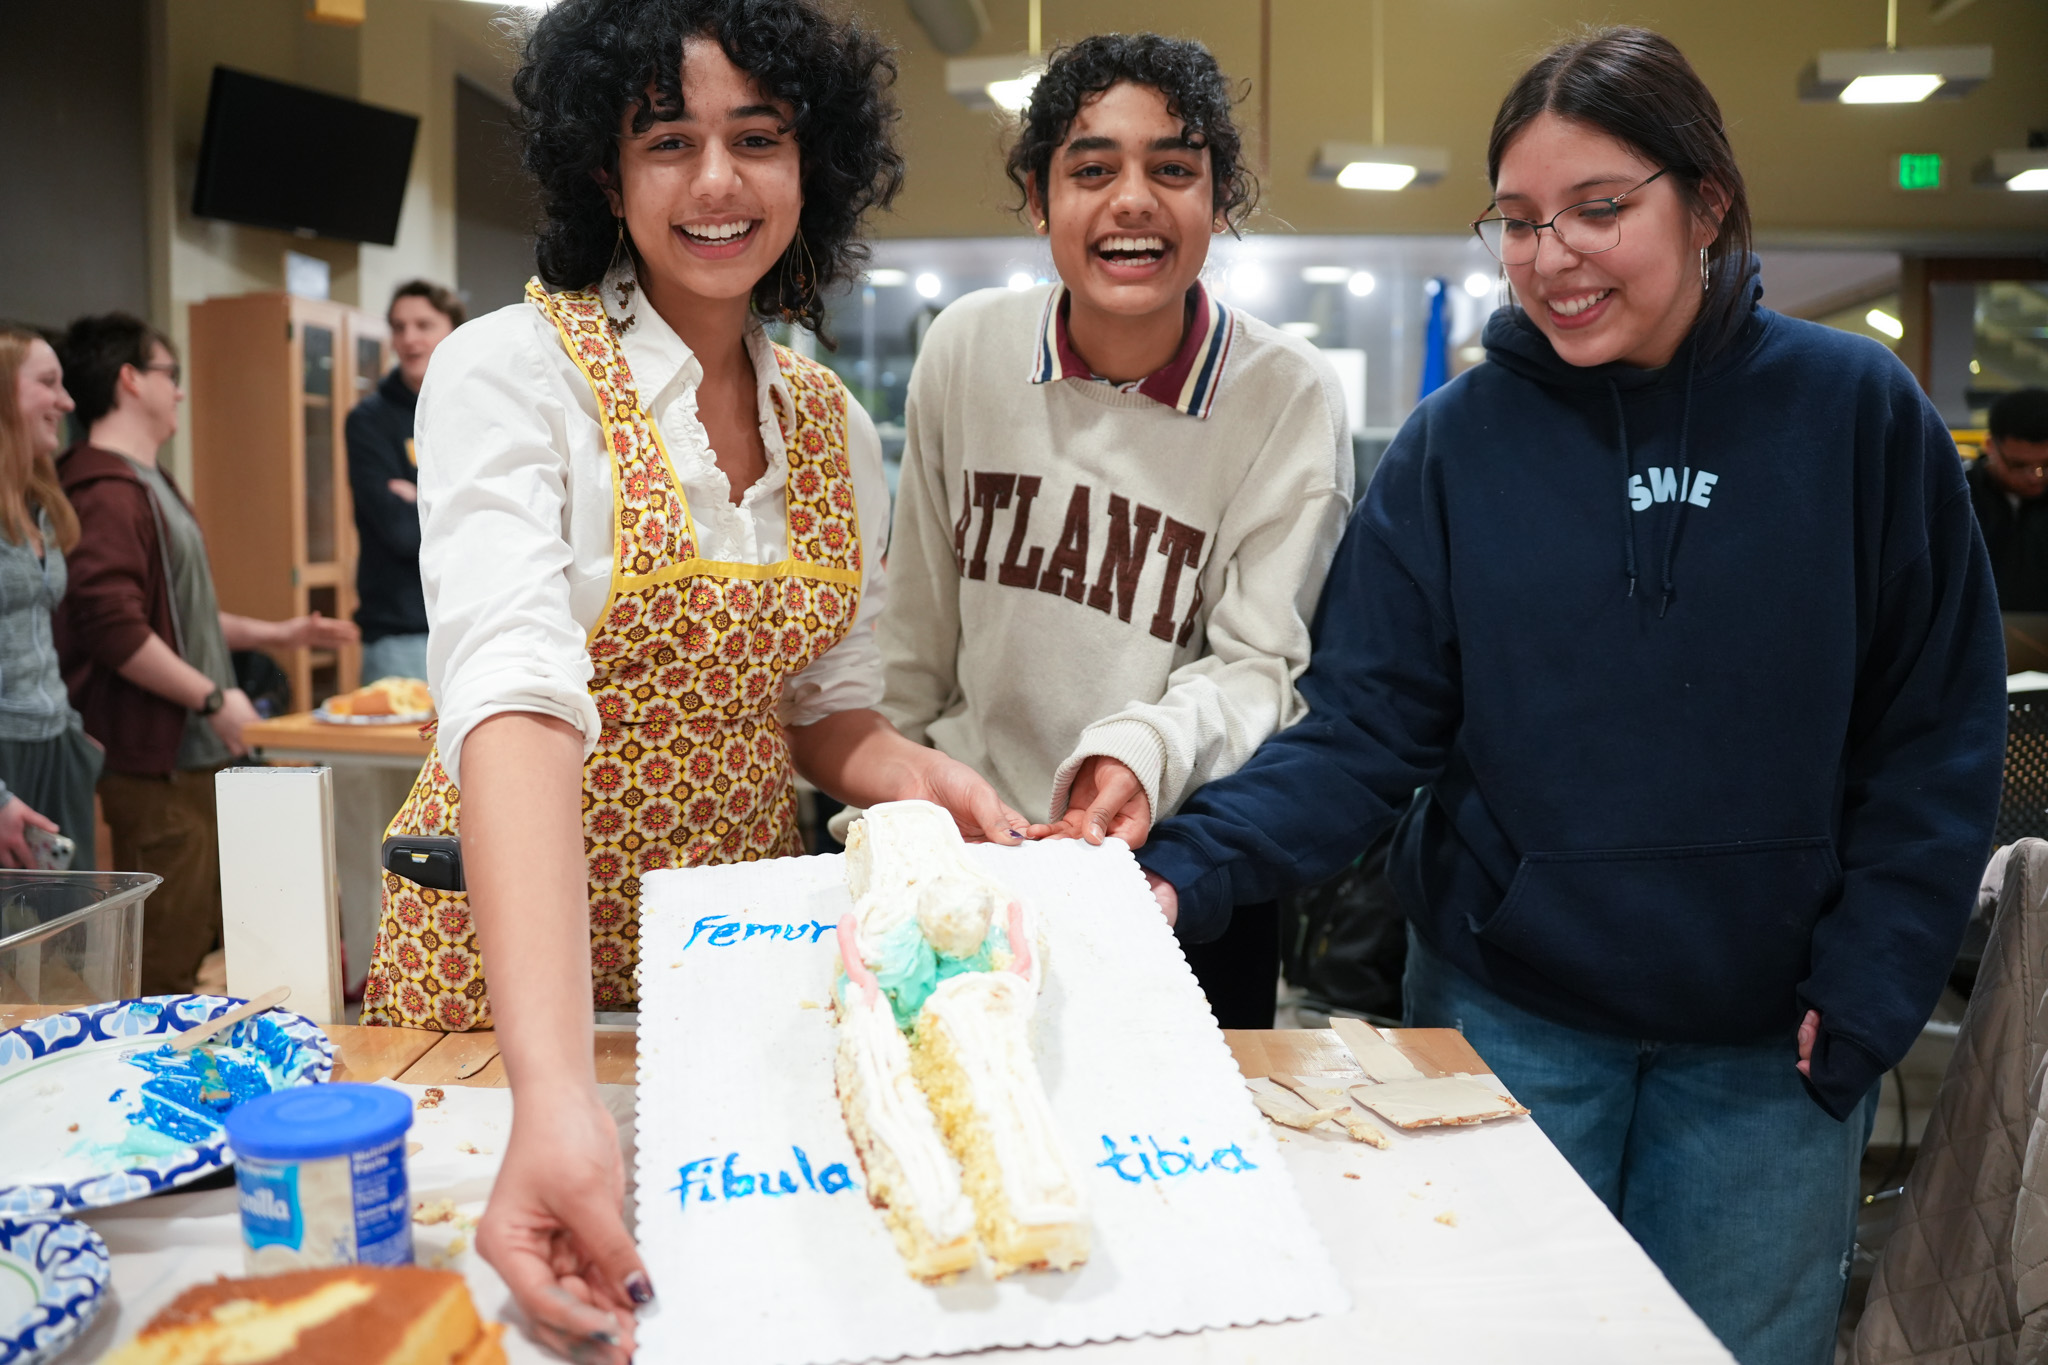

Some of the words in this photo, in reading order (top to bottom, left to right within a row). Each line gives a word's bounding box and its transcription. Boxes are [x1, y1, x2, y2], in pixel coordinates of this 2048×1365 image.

[1628, 466, 1719, 512] SWE
[683, 914, 837, 950] Femur
[1097, 1134, 1258, 1184] tibia
